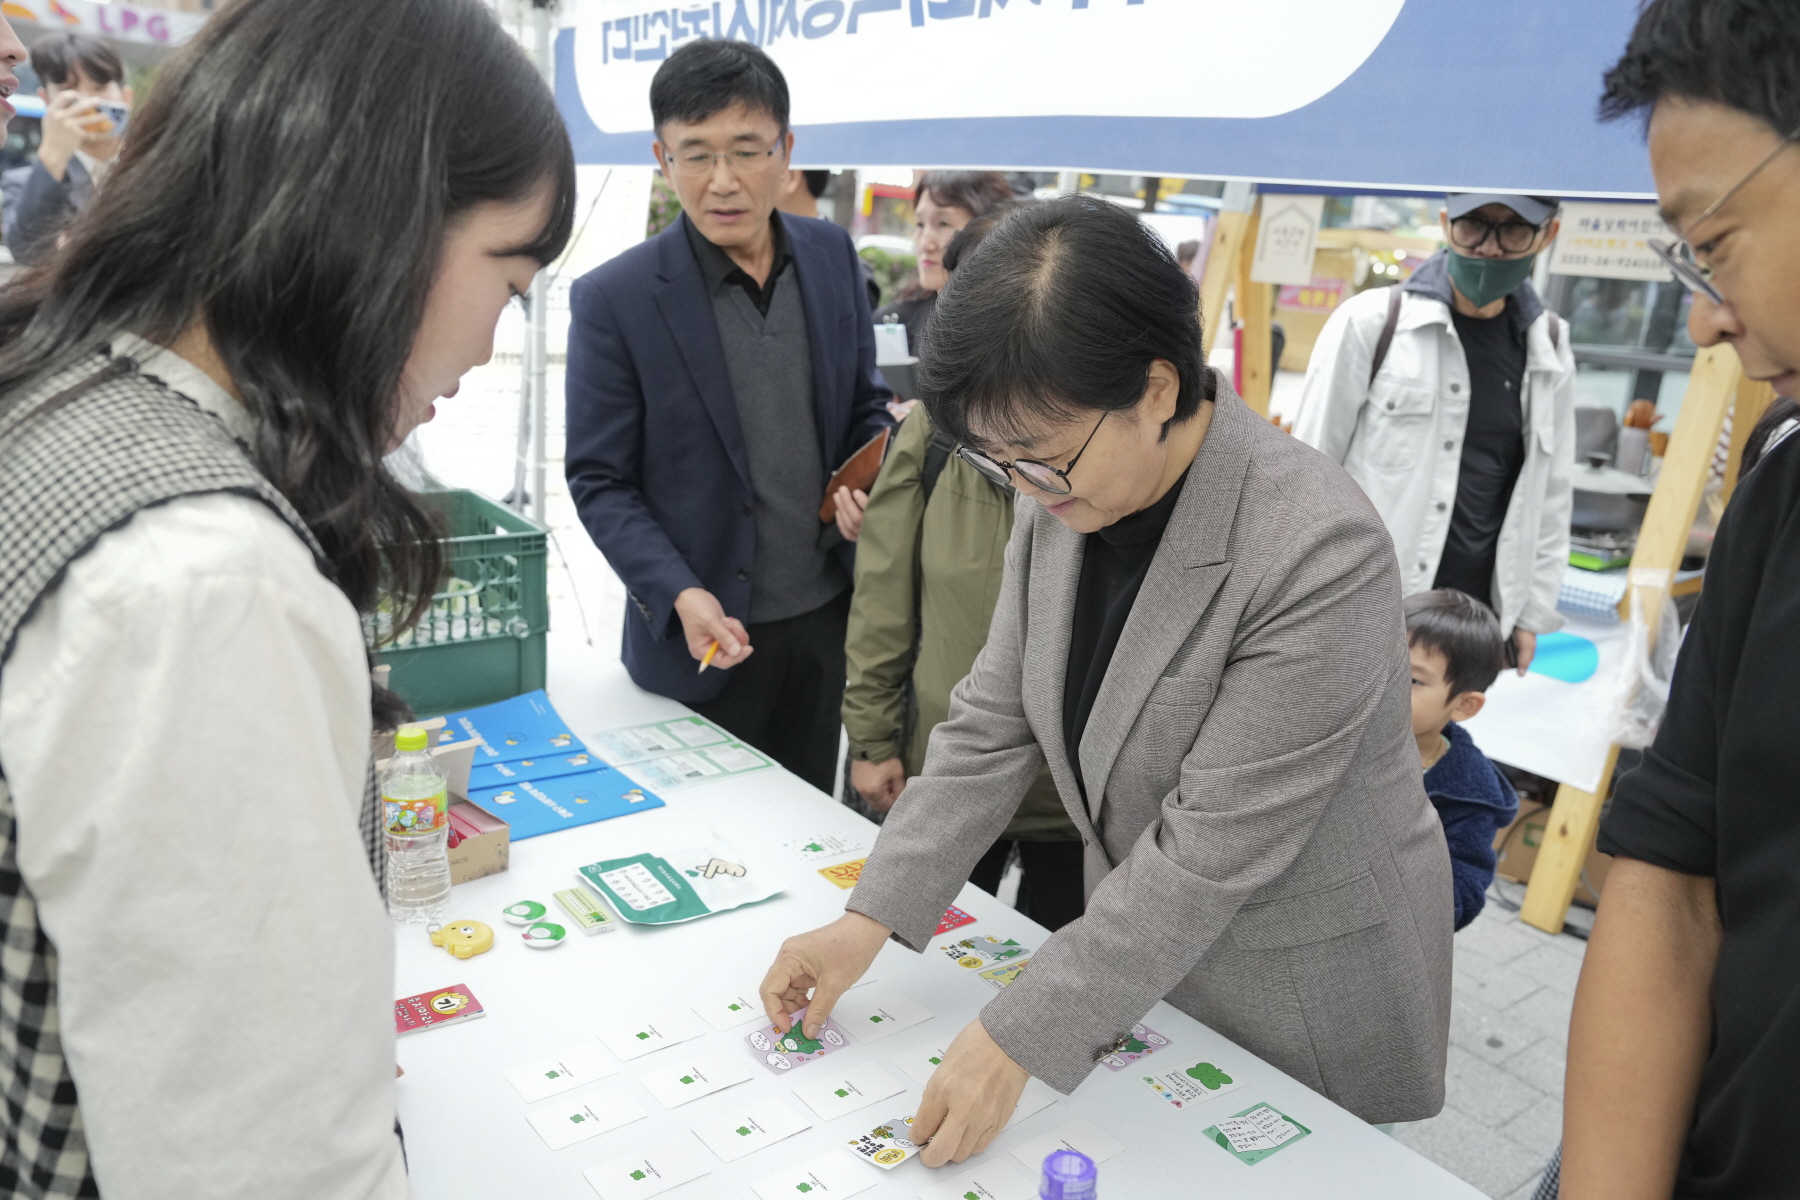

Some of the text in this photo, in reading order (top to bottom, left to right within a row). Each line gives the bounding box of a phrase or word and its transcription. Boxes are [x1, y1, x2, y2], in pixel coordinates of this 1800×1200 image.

[98, 7, 171, 41] LPG
[407, 996, 435, 1024] 죽지마라
[438, 998, 456, 1010] 기
